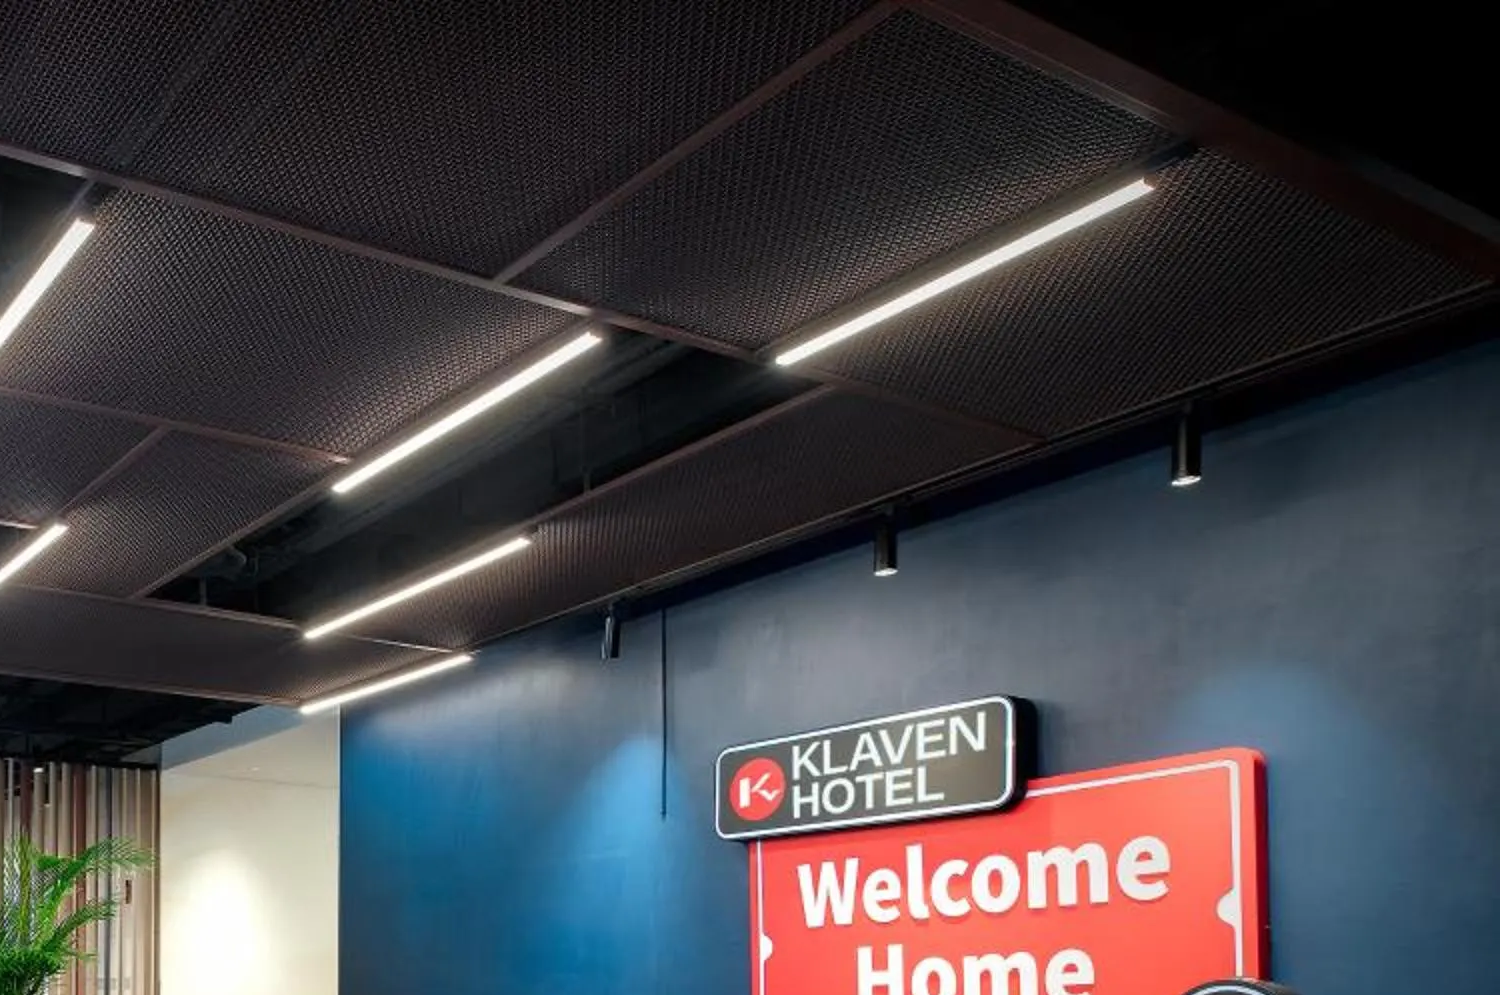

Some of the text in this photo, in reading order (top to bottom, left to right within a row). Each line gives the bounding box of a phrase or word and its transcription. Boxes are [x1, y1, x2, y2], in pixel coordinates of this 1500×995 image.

[792, 711, 987, 779] KLAVEN
[792, 763, 944, 819] HOTEL
[798, 836, 1170, 928] Welcome
